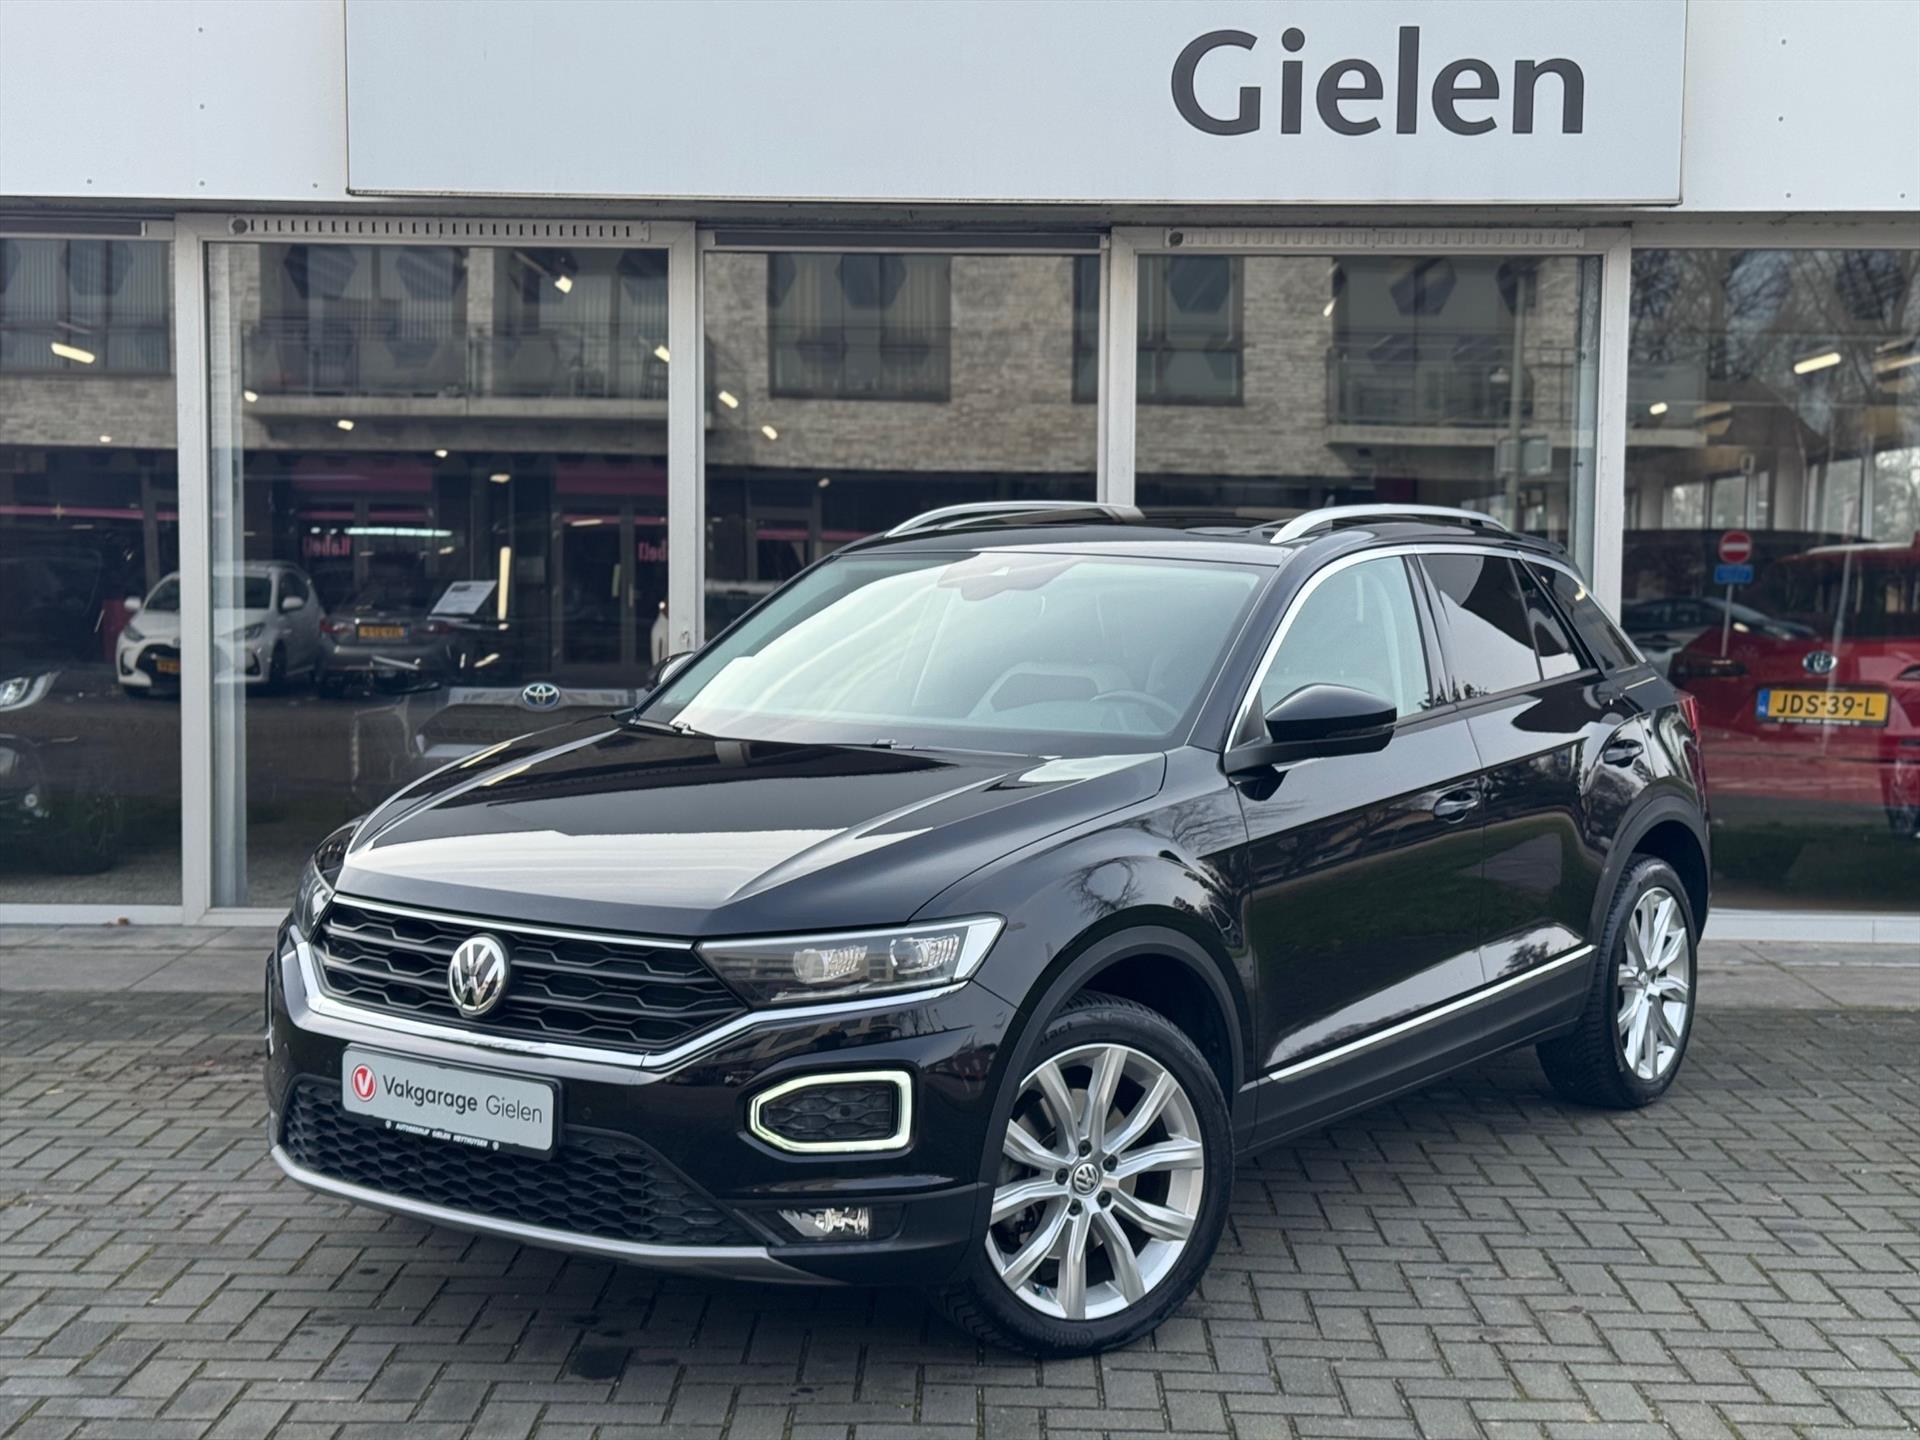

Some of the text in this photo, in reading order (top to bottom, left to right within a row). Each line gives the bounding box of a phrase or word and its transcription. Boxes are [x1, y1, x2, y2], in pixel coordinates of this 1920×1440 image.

[1171, 26, 1584, 136] Gielen
[1777, 694, 1876, 716] JDS-39-L
[383, 1074, 543, 1124] Vakgarage Gielen
